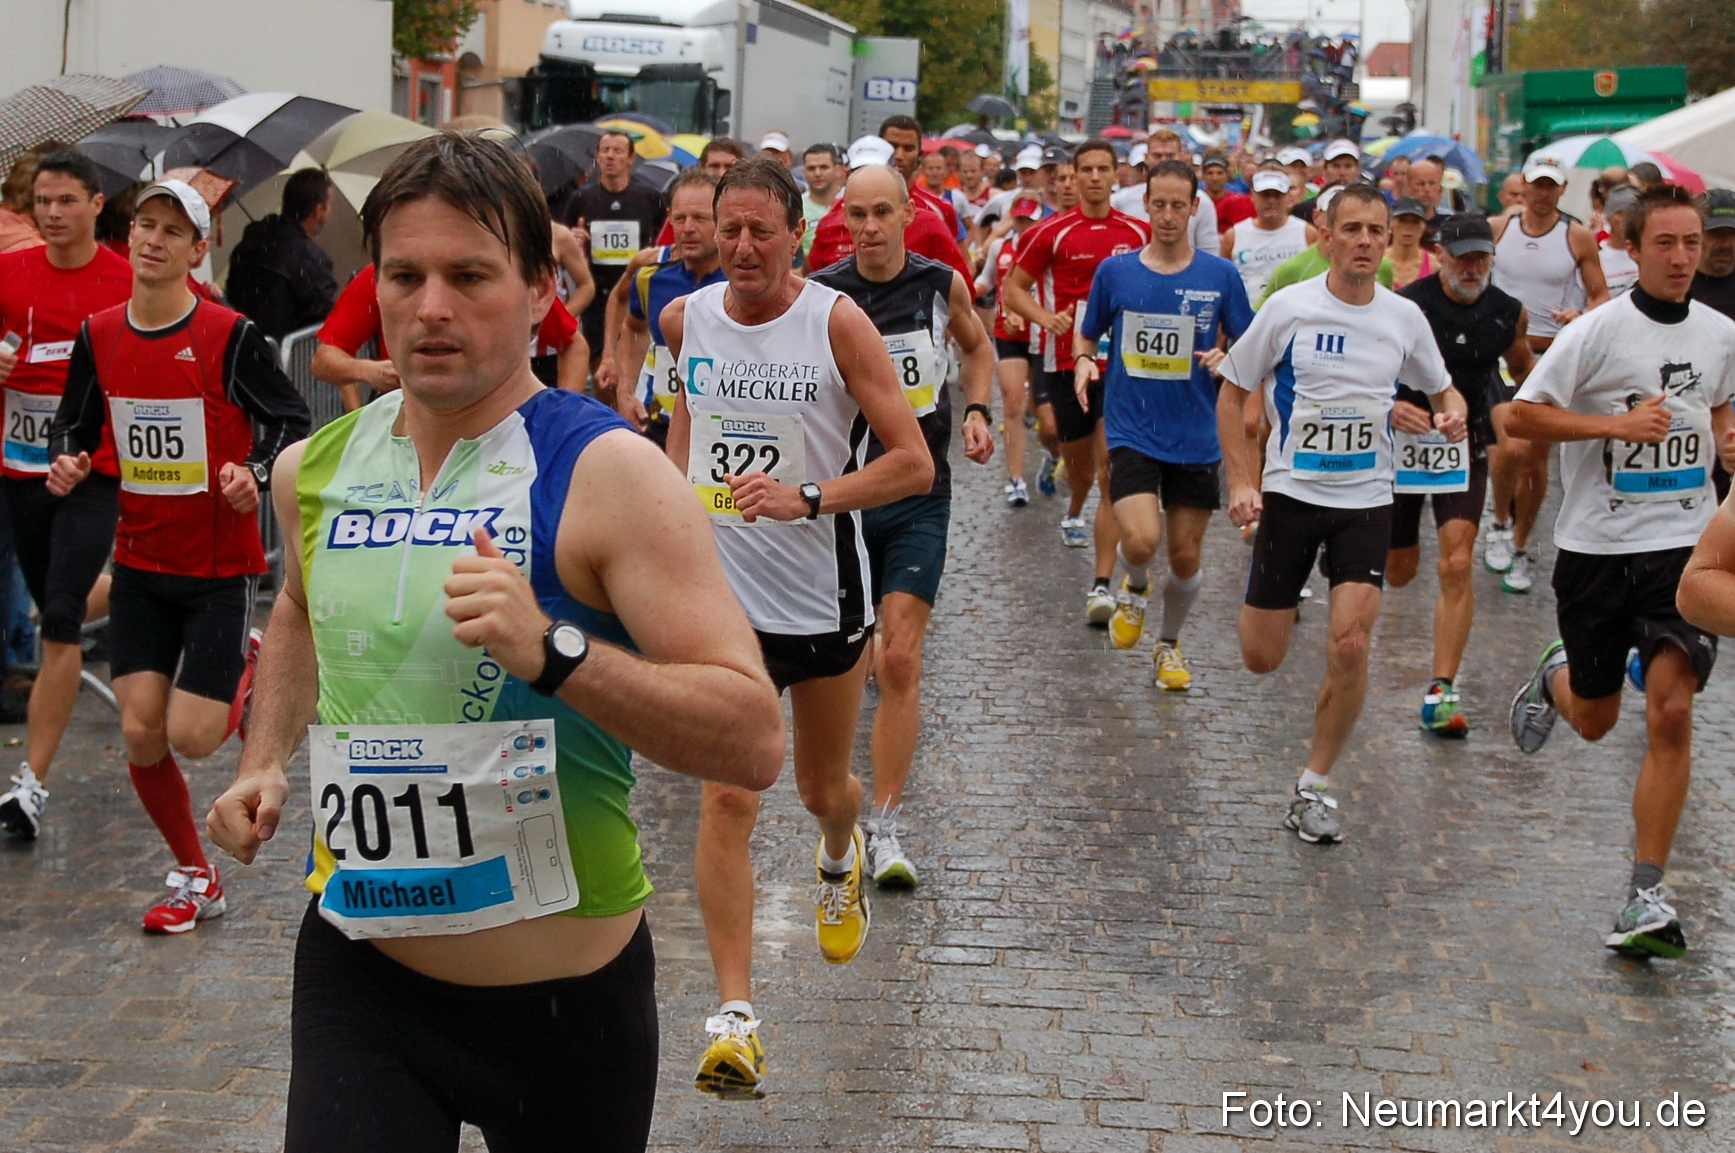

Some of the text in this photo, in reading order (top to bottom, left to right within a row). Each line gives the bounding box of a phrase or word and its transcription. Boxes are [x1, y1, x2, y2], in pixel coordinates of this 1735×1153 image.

[1199, 84, 1249, 97] START
[601, 233, 629, 249] 103
[1136, 330, 1179, 356] 640
[721, 360, 820, 380] HÖRGERÄTE
[1141, 359, 1169, 370] Simon
[716, 378, 818, 402] MECKLER
[721, 419, 766, 433] BOCK
[1302, 422, 1373, 451] 2115
[128, 424, 184, 460] 605
[1623, 433, 1700, 469] 2109
[710, 442, 780, 483] 322
[1402, 445, 1461, 470] 3429
[132, 466, 182, 481] Andreas
[1648, 477, 1678, 489] Maxi
[344, 478, 459, 504] TEAM
[326, 507, 505, 550] BOCK
[349, 739, 424, 761] BOCK
[320, 783, 475, 862] 2011
[342, 879, 457, 909] Michael
